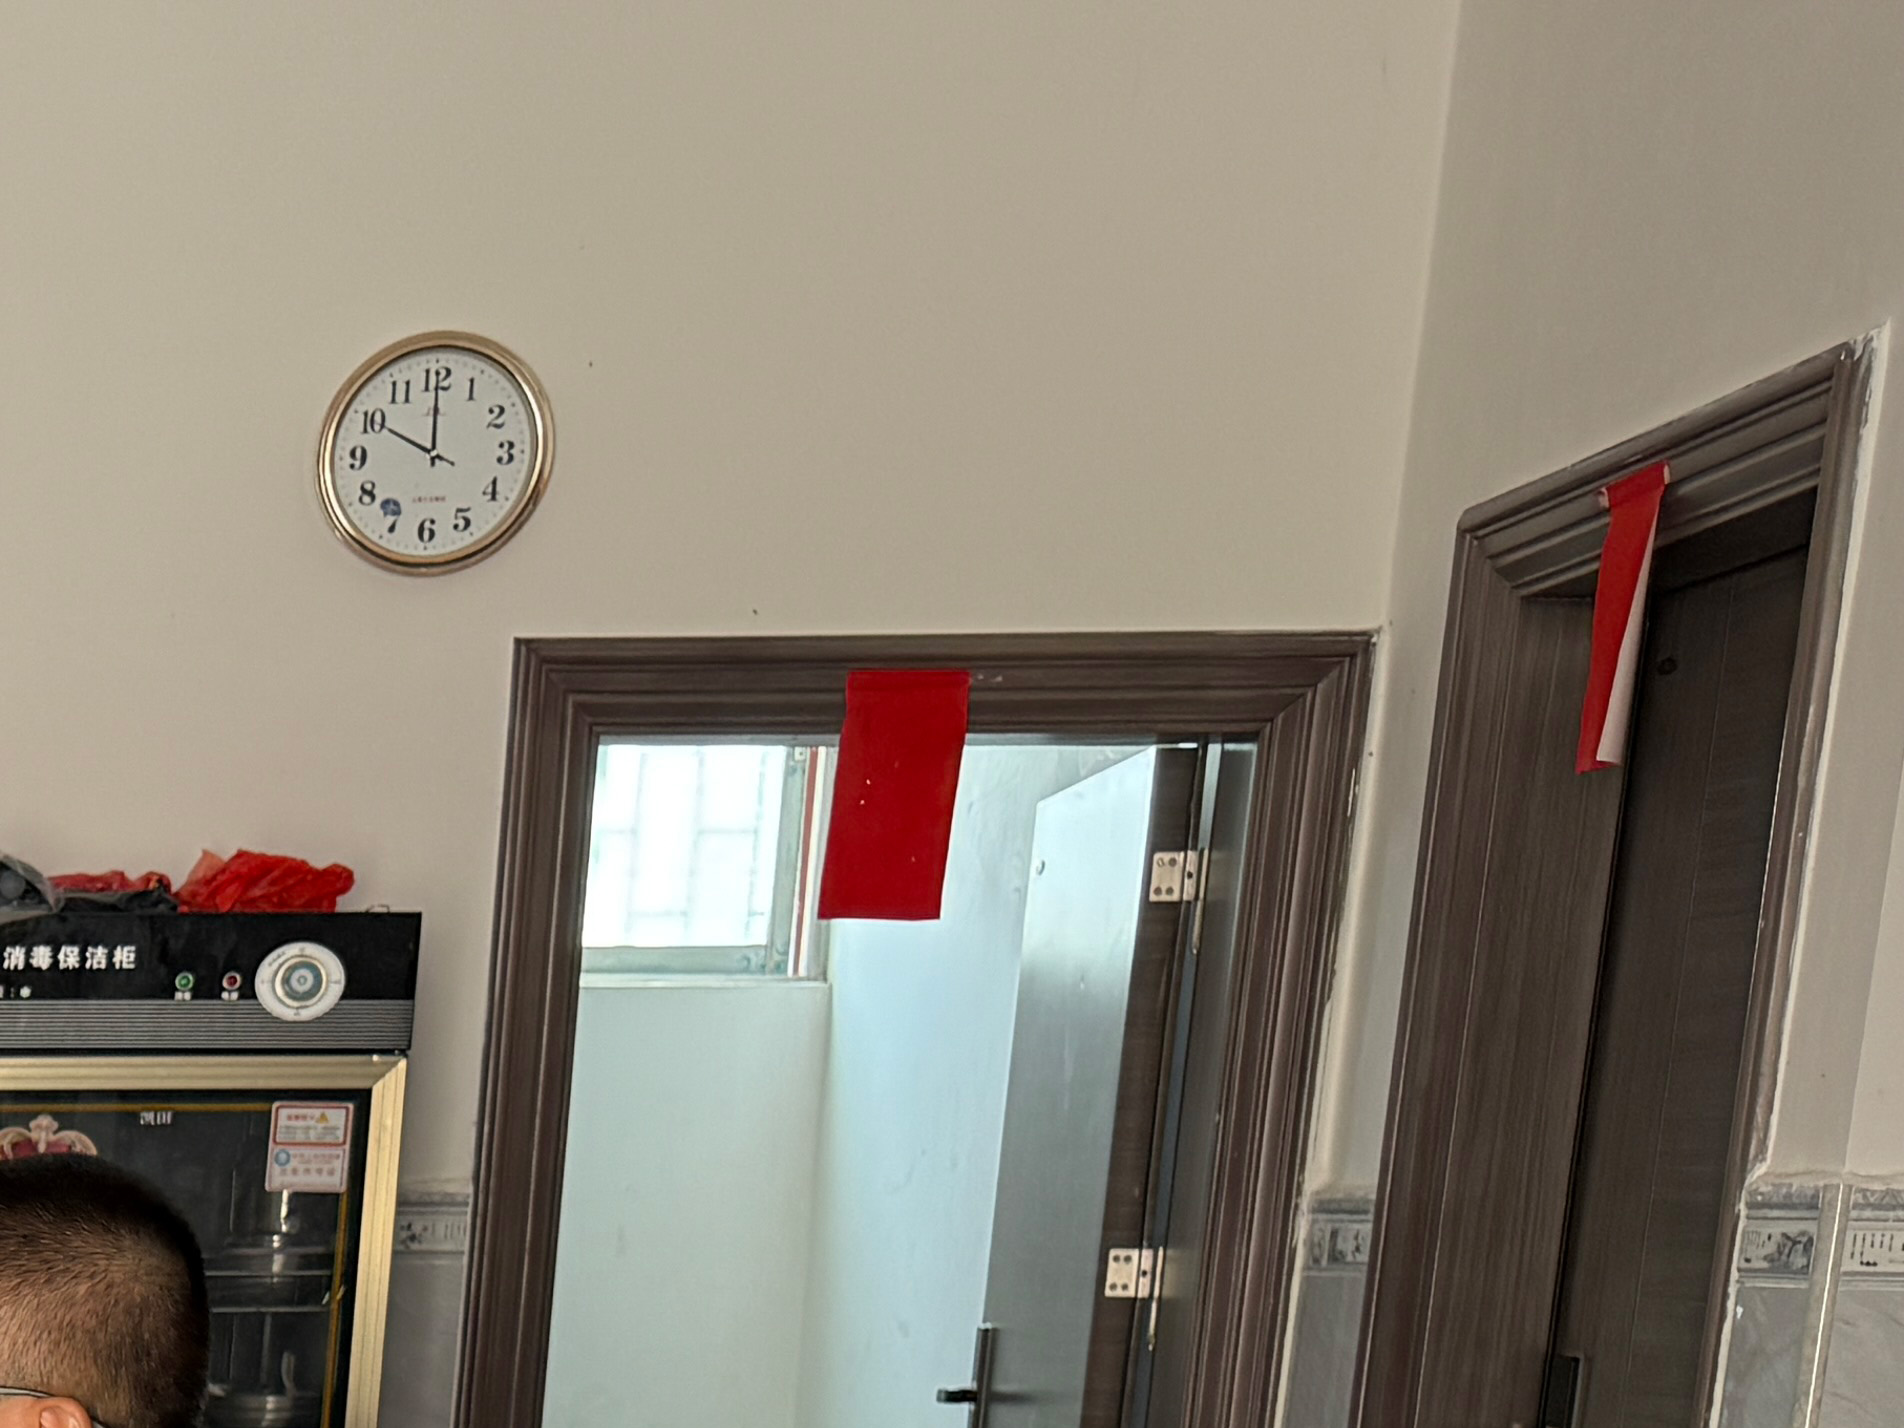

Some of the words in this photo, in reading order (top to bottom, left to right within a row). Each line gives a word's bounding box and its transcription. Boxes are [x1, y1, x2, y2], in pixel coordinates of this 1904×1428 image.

[421, 366, 452, 392] 12
[466, 377, 476, 402] 1
[388, 379, 411, 405] 11
[361, 408, 386, 434] 10
[486, 404, 505, 429] 2
[349, 445, 368, 470] 9
[496, 440, 515, 465] 3
[358, 480, 376, 505] 8
[482, 476, 499, 502] 4
[417, 518, 436, 543] 6
[453, 507, 472, 532] 5
